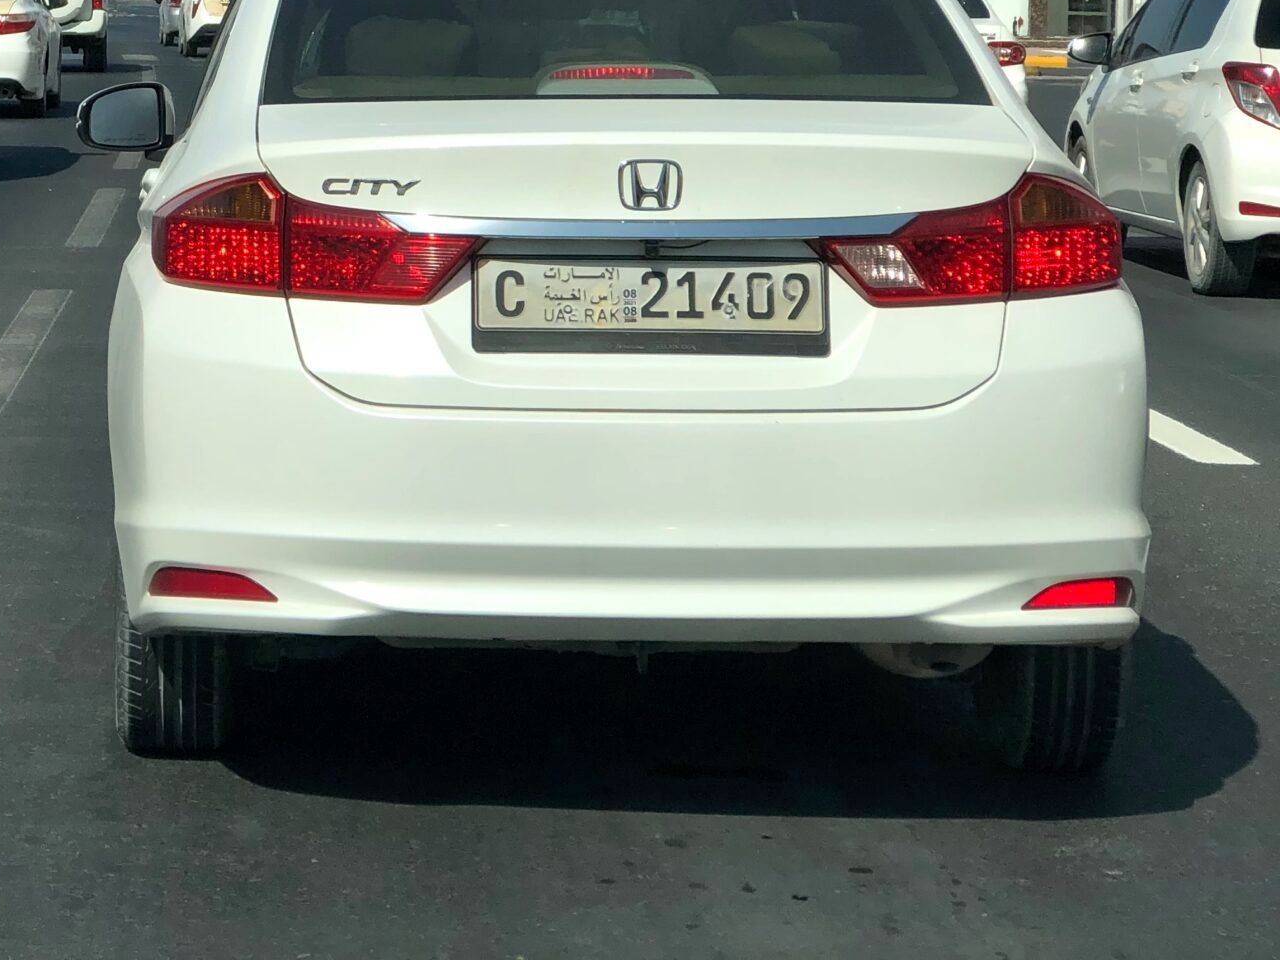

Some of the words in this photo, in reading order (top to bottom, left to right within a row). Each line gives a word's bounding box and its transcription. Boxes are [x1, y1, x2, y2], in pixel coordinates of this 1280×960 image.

[321, 178, 422, 196] CITY
[495, 269, 525, 318] C
[544, 285, 587, 306] الخيمة
[589, 283, 620, 305] رأس
[622, 288, 637, 299] 08
[640, 271, 811, 320] 21409
[622, 306, 638, 316] 08
